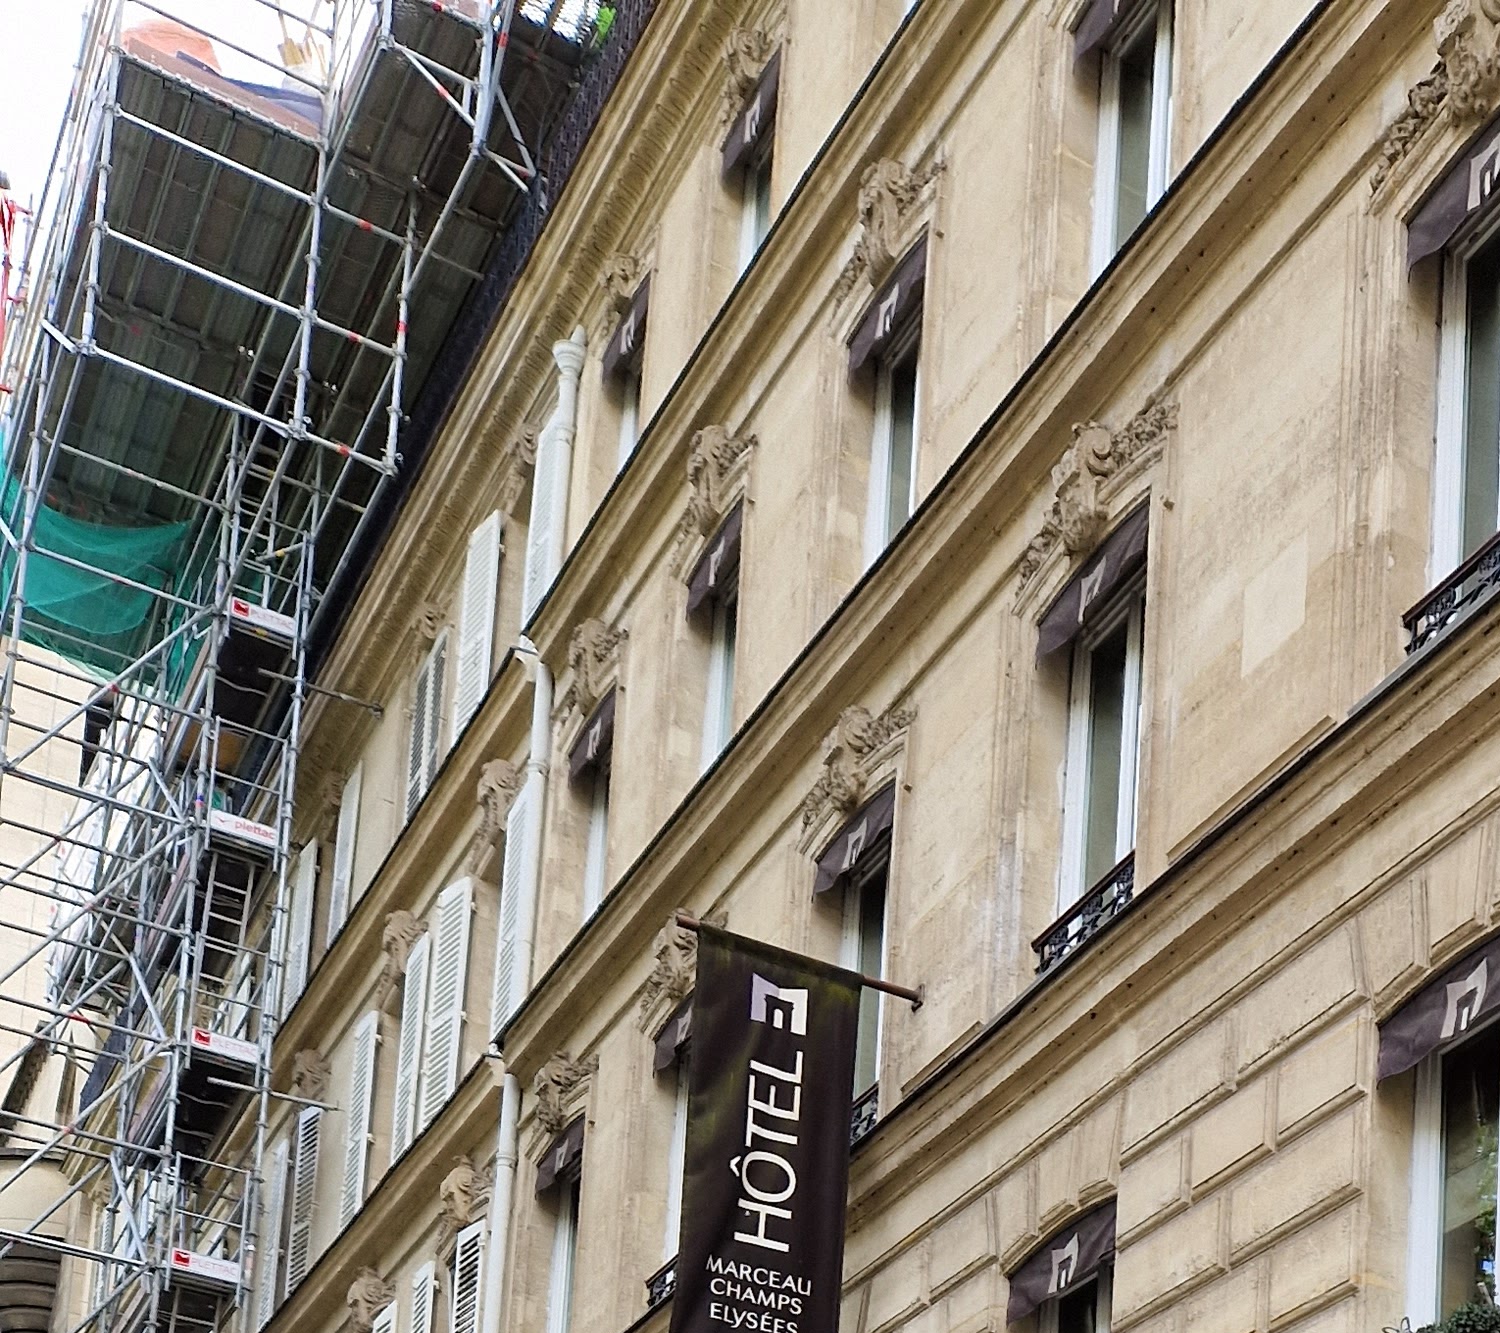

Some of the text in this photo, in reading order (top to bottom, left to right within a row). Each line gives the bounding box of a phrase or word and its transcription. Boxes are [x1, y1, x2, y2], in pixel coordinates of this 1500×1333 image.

[729, 1050, 804, 1253] HÔTEL
[706, 1254, 812, 1297] MARCEAU
[710, 1276, 803, 1316] CHAMPS
